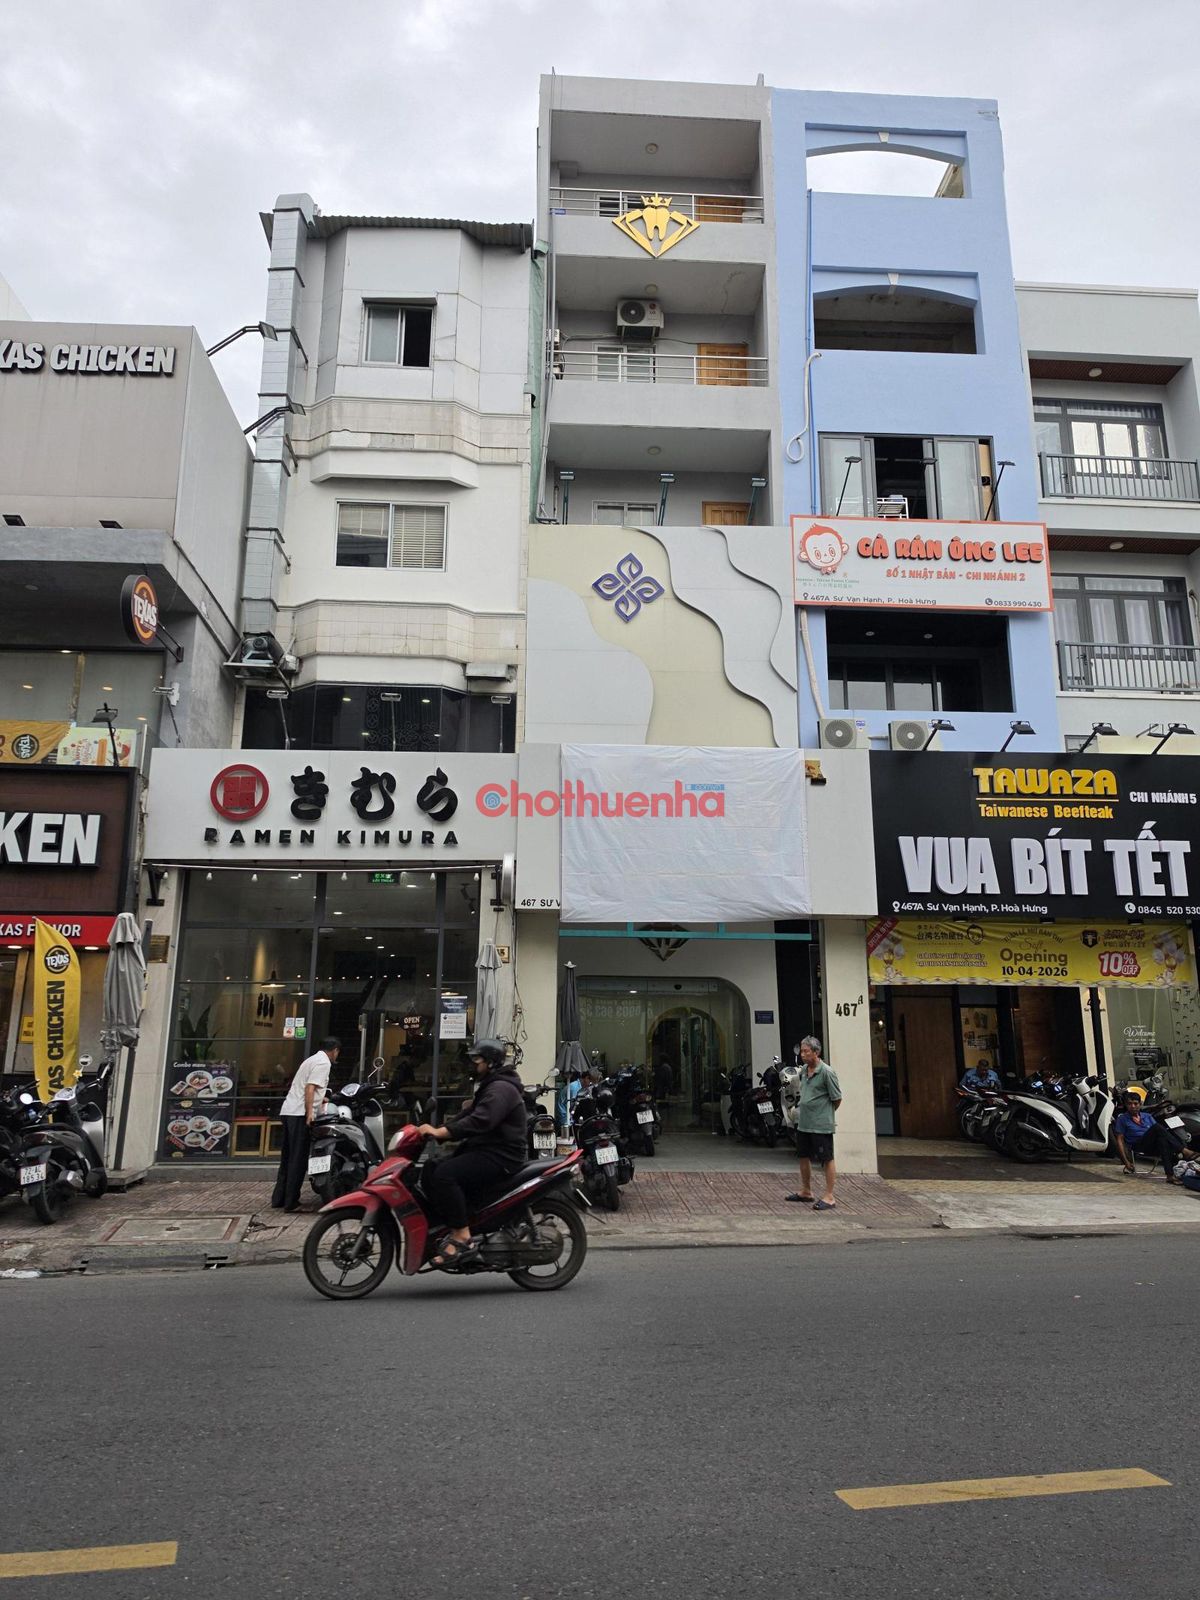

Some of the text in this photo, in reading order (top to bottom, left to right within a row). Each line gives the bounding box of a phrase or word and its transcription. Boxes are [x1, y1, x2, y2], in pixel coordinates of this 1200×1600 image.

[50, 343, 175, 374] CHICKEN
[857, 533, 1044, 563] GÀ RÁN ÔNG LEE
[886, 566, 899, 578] SỐ
[901, 569, 906, 578] 1
[909, 567, 934, 580] NHẬT
[965, 571, 981, 580] CHI
[983, 569, 1018, 581] NHÁNH
[1019, 572, 1025, 581] 2
[134, 594, 157, 627] TEXAS
[972, 767, 1117, 796] TAWAZA
[290, 764, 459, 822] きむら
[1129, 789, 1197, 804] CHI NHÁNH 5
[979, 803, 1114, 820] Taiwanese Beefteak
[204, 827, 458, 845] RAMEN KIMURA
[898, 821, 1191, 896] VUA BÍT TẾT
[520, 899, 536, 907] 467
[901, 902, 1048, 914] 467A Sư Vạn Hạnh, P. Hoà Hưng
[1138, 905, 1162, 914] 0845
[1166, 906, 1183, 914] 520
[26, 923, 82, 937] FVOR
[45, 953, 70, 967] TEXAS
[1000, 947, 1068, 966] Opening
[1101, 953, 1134, 973] 10%
[1001, 966, 1068, 976] 10-04-2026
[1122, 964, 1138, 975] OFF
[47, 980, 65, 1061] CHICKEN
[404, 1016, 421, 1024] OPEN
